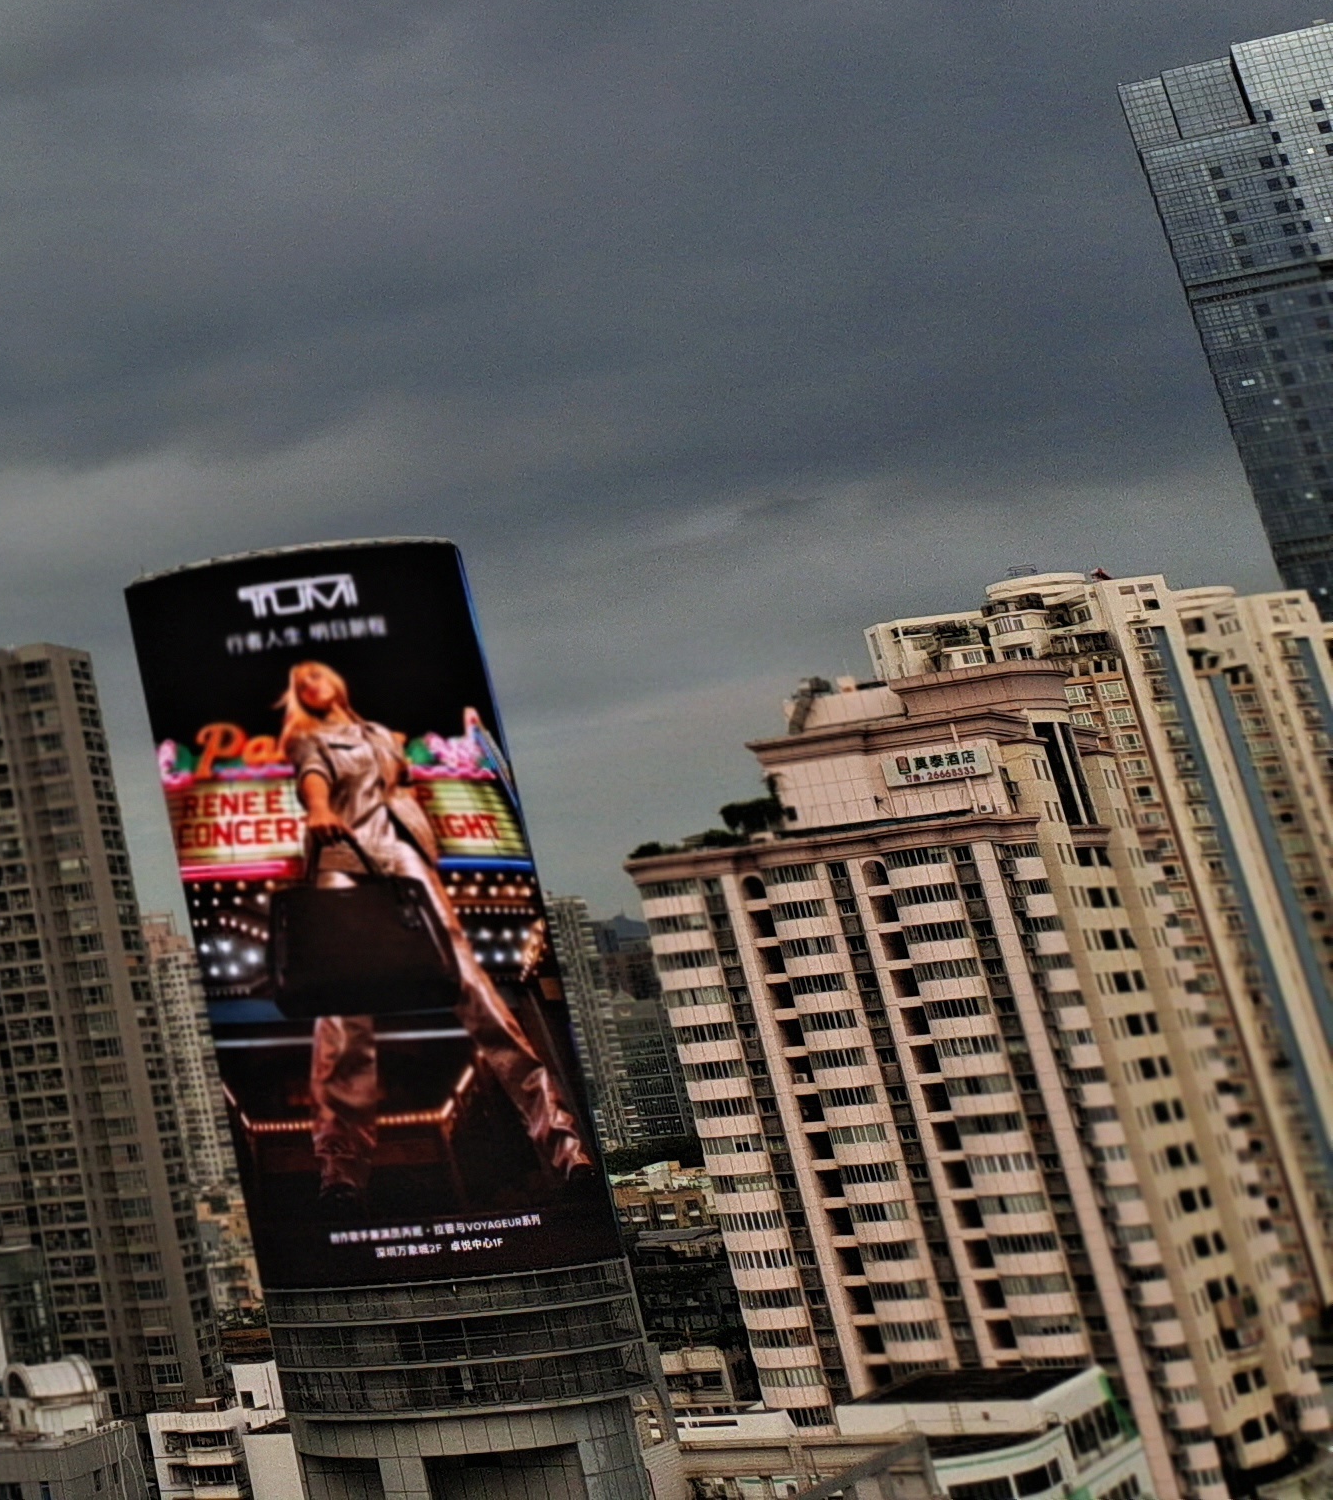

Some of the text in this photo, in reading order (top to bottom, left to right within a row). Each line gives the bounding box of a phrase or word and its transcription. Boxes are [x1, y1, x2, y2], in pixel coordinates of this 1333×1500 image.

[238, 574, 359, 618] TUMI
[196, 722, 287, 779] Pa
[913, 750, 976, 770] 莫泰酒店
[432, 813, 502, 840] IGHT
[375, 1237, 504, 1259] 深圳万象城2F 卓悦中心1F
